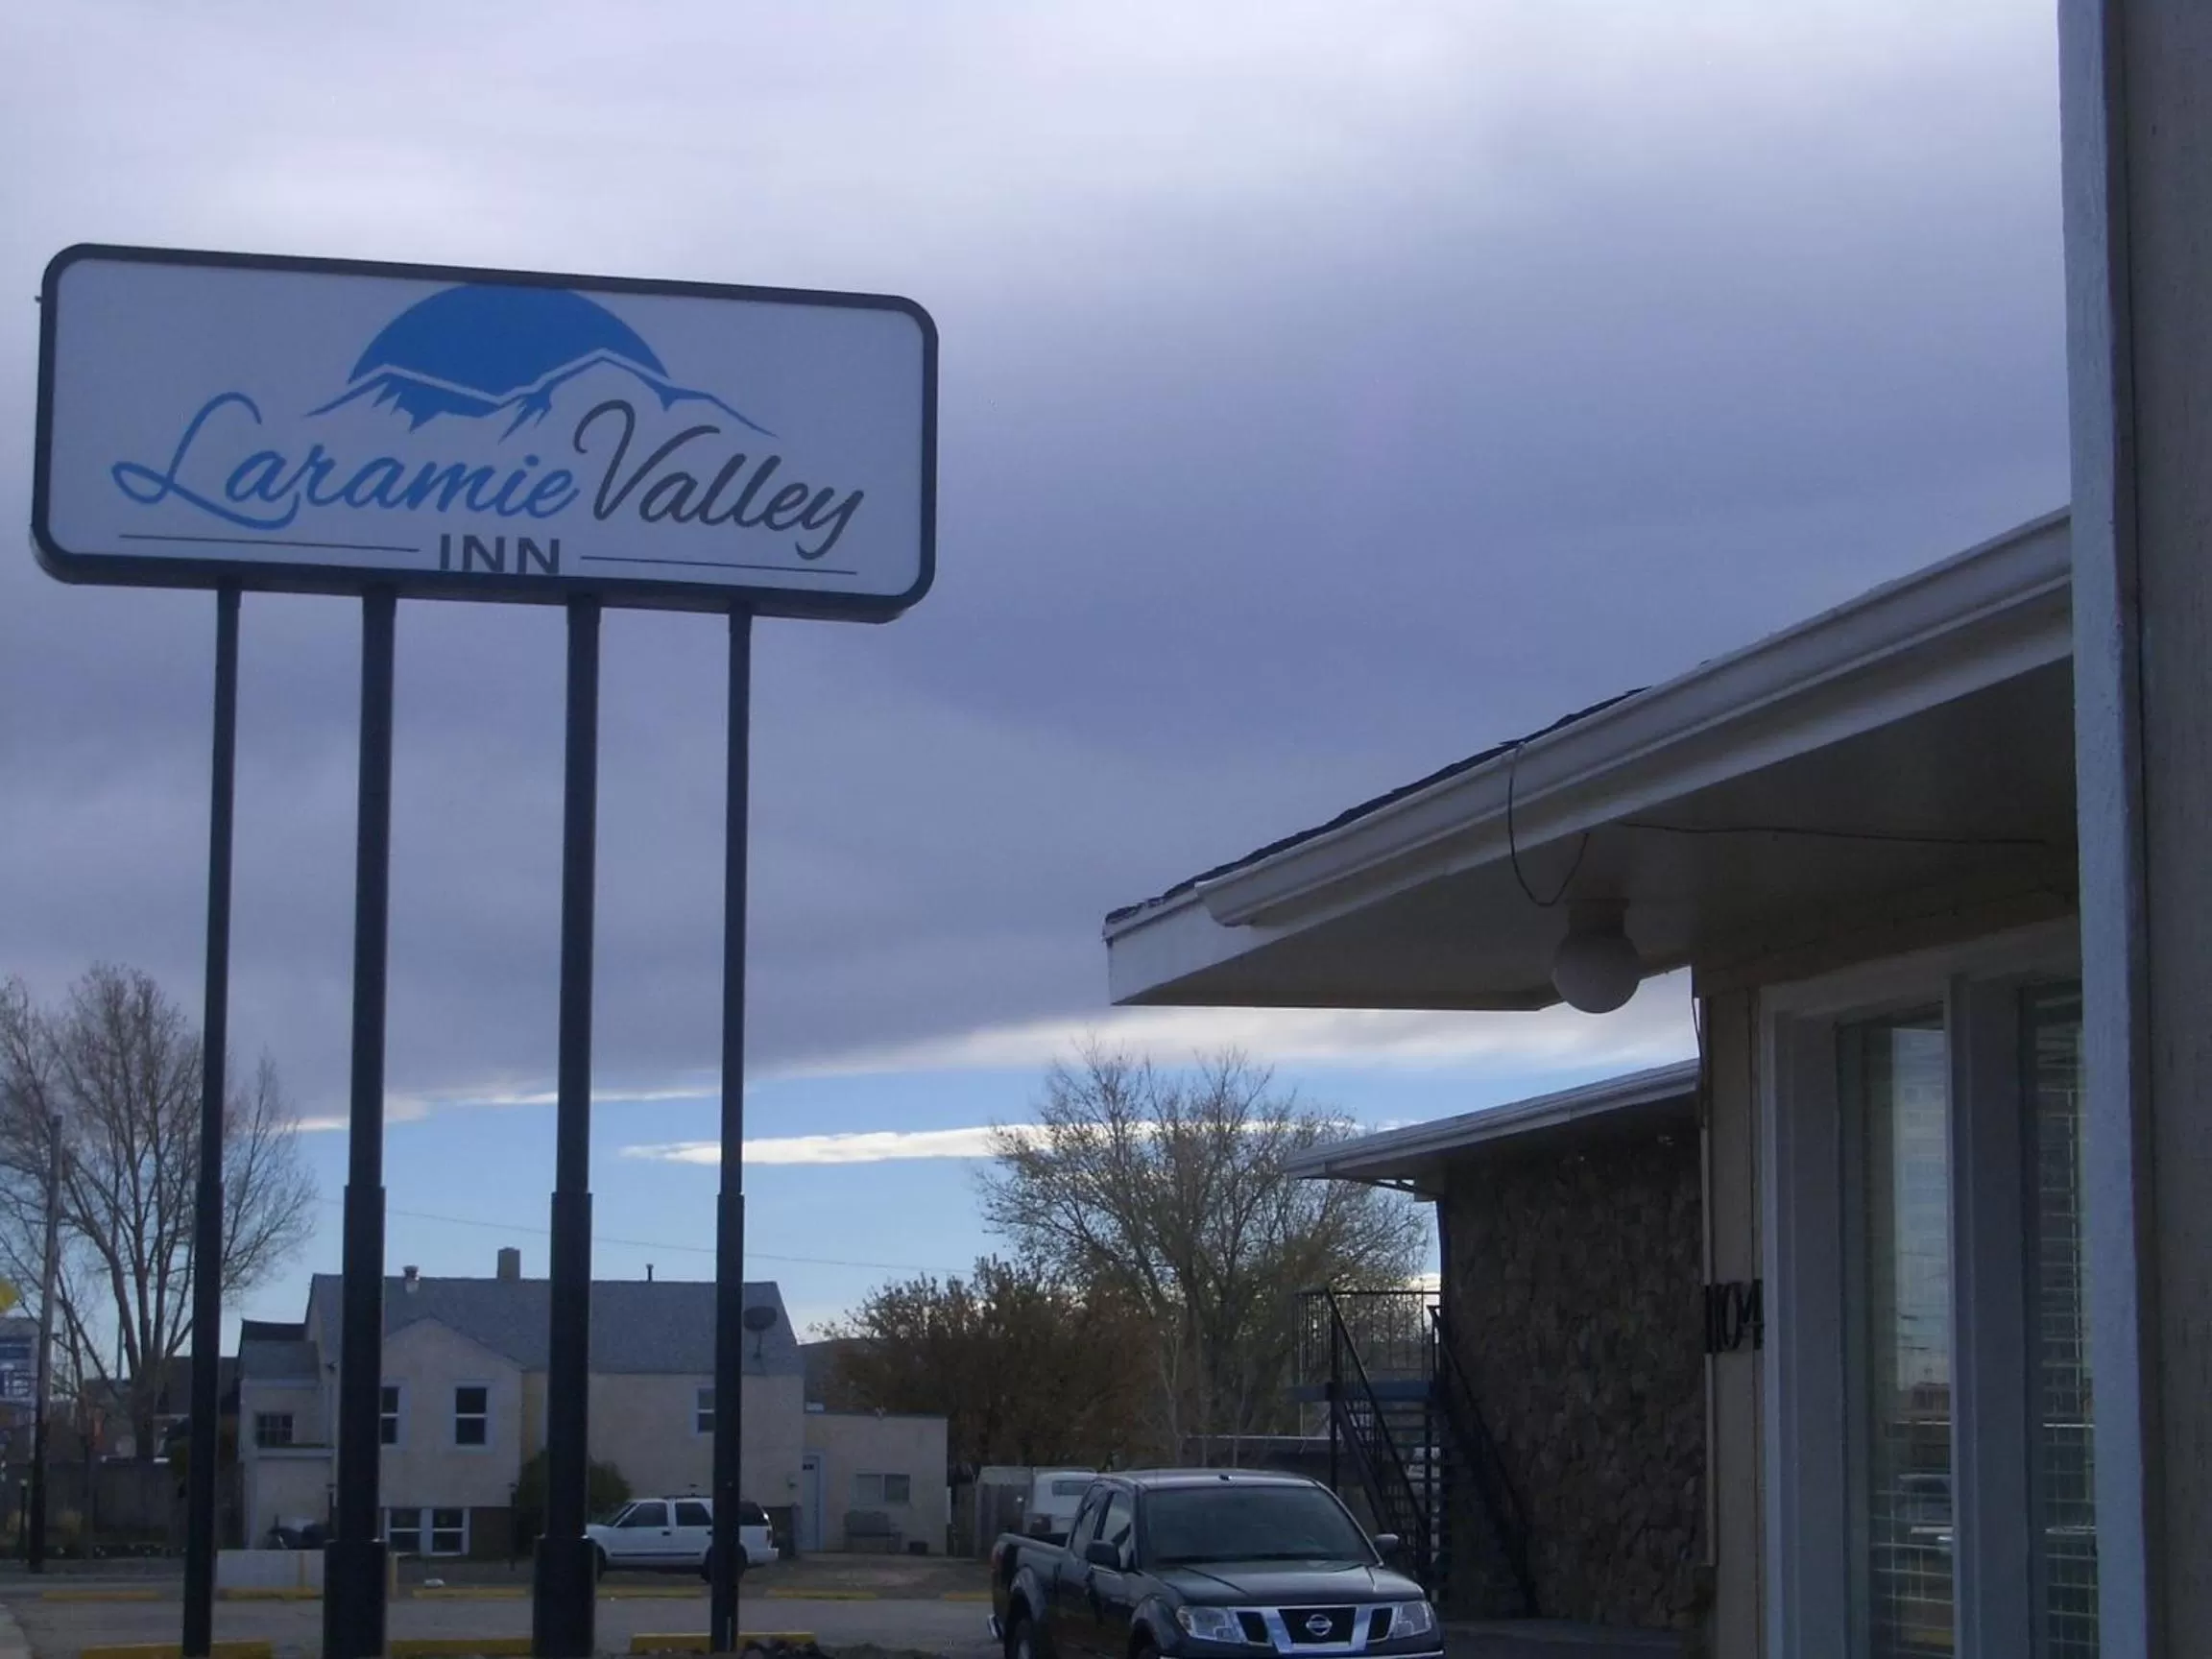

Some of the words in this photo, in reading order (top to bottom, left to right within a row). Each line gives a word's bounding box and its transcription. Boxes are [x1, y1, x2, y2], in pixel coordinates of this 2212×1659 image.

[111, 392, 580, 530] Laramie
[573, 398, 864, 561] Valley
[439, 533, 561, 575] INN
